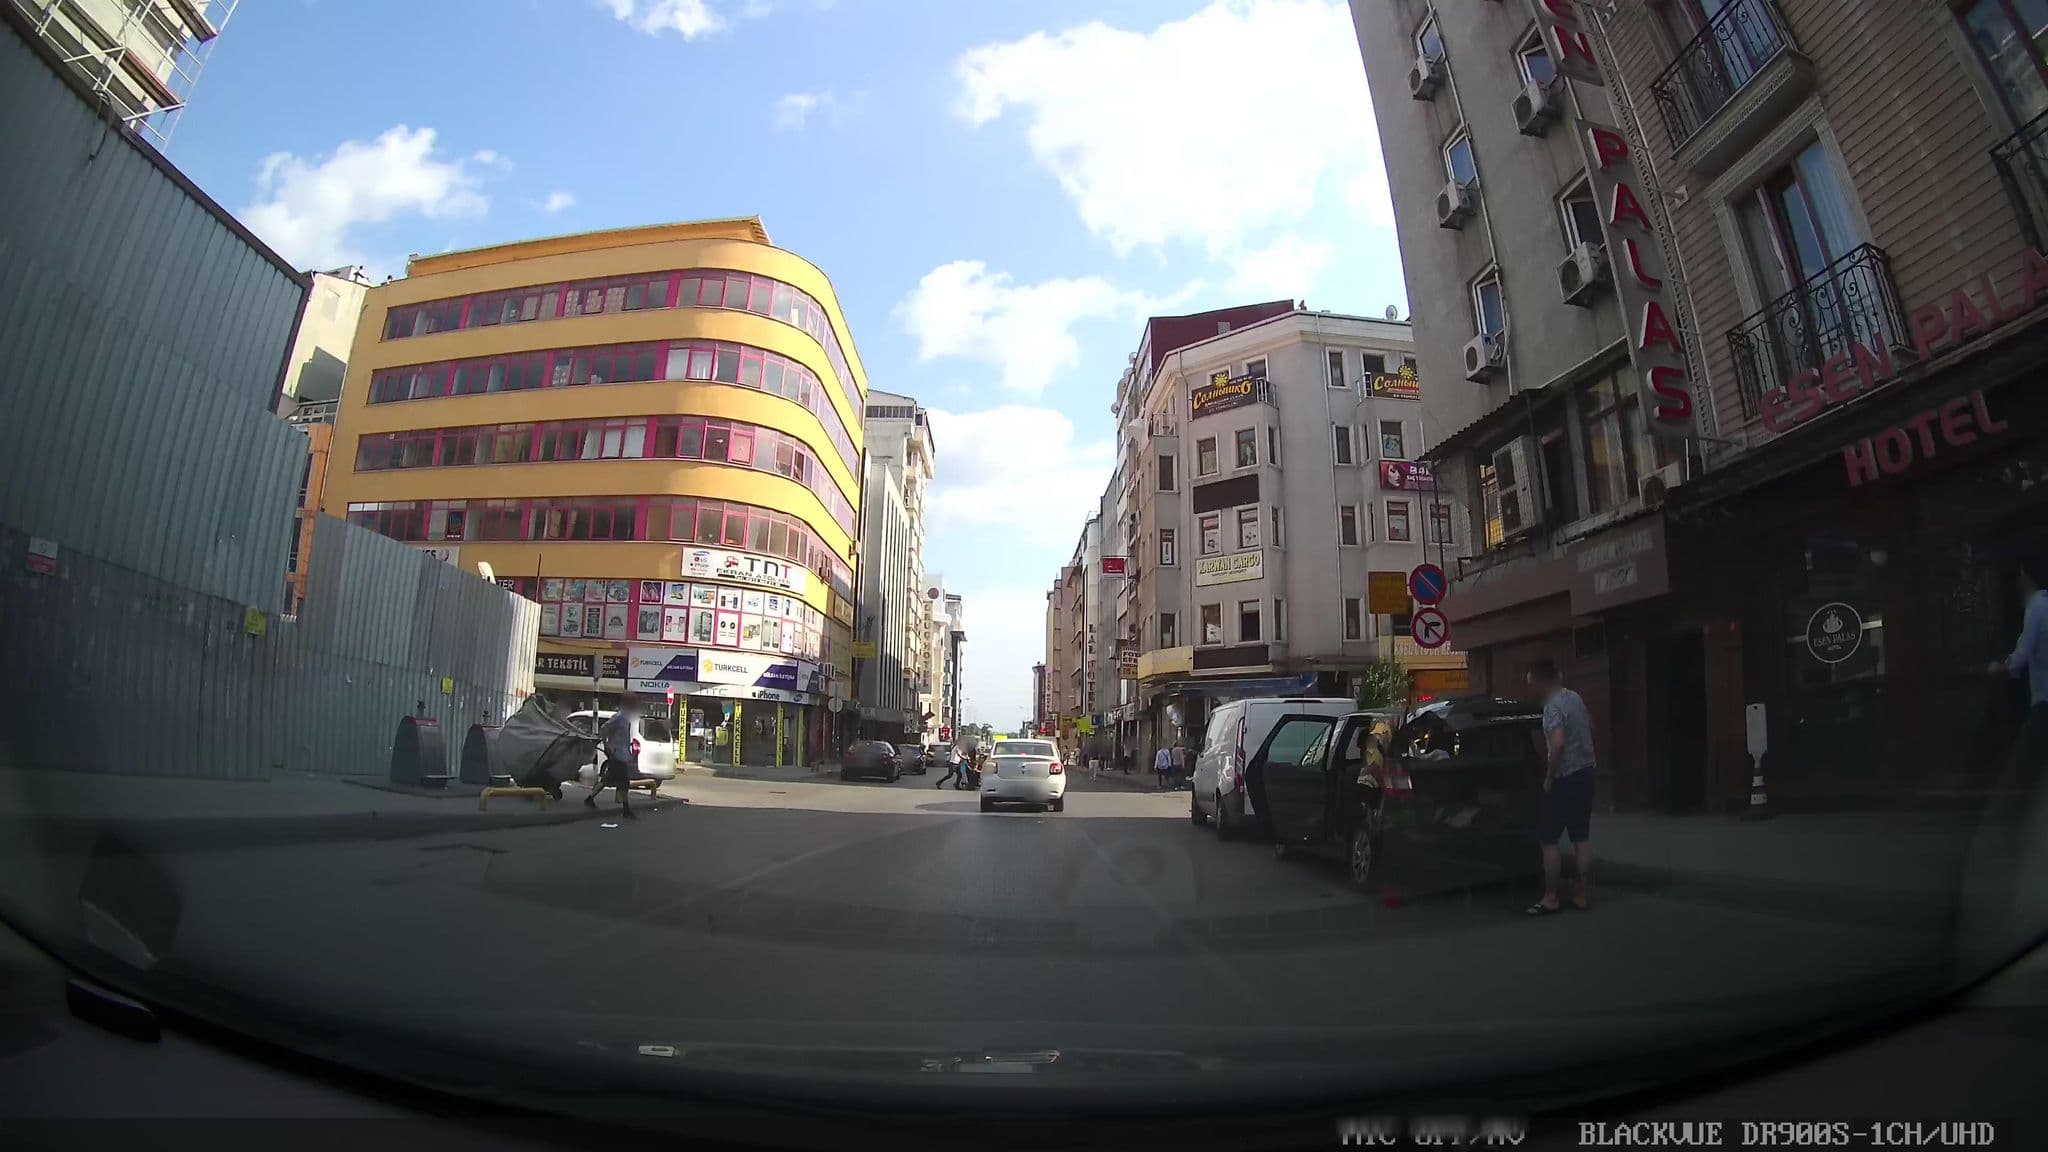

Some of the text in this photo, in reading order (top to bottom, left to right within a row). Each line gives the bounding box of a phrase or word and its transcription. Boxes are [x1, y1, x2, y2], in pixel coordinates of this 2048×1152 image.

[1586, 126, 1693, 426] PALAS
[1759, 331, 1898, 434] ESEN
[1842, 390, 2008, 488] HOTEL
[547, 656, 589, 671] TEKSTİL
[714, 663, 748, 674] TURKCELL
[640, 680, 670, 689] NOKIA
[757, 688, 780, 701] iPhone
